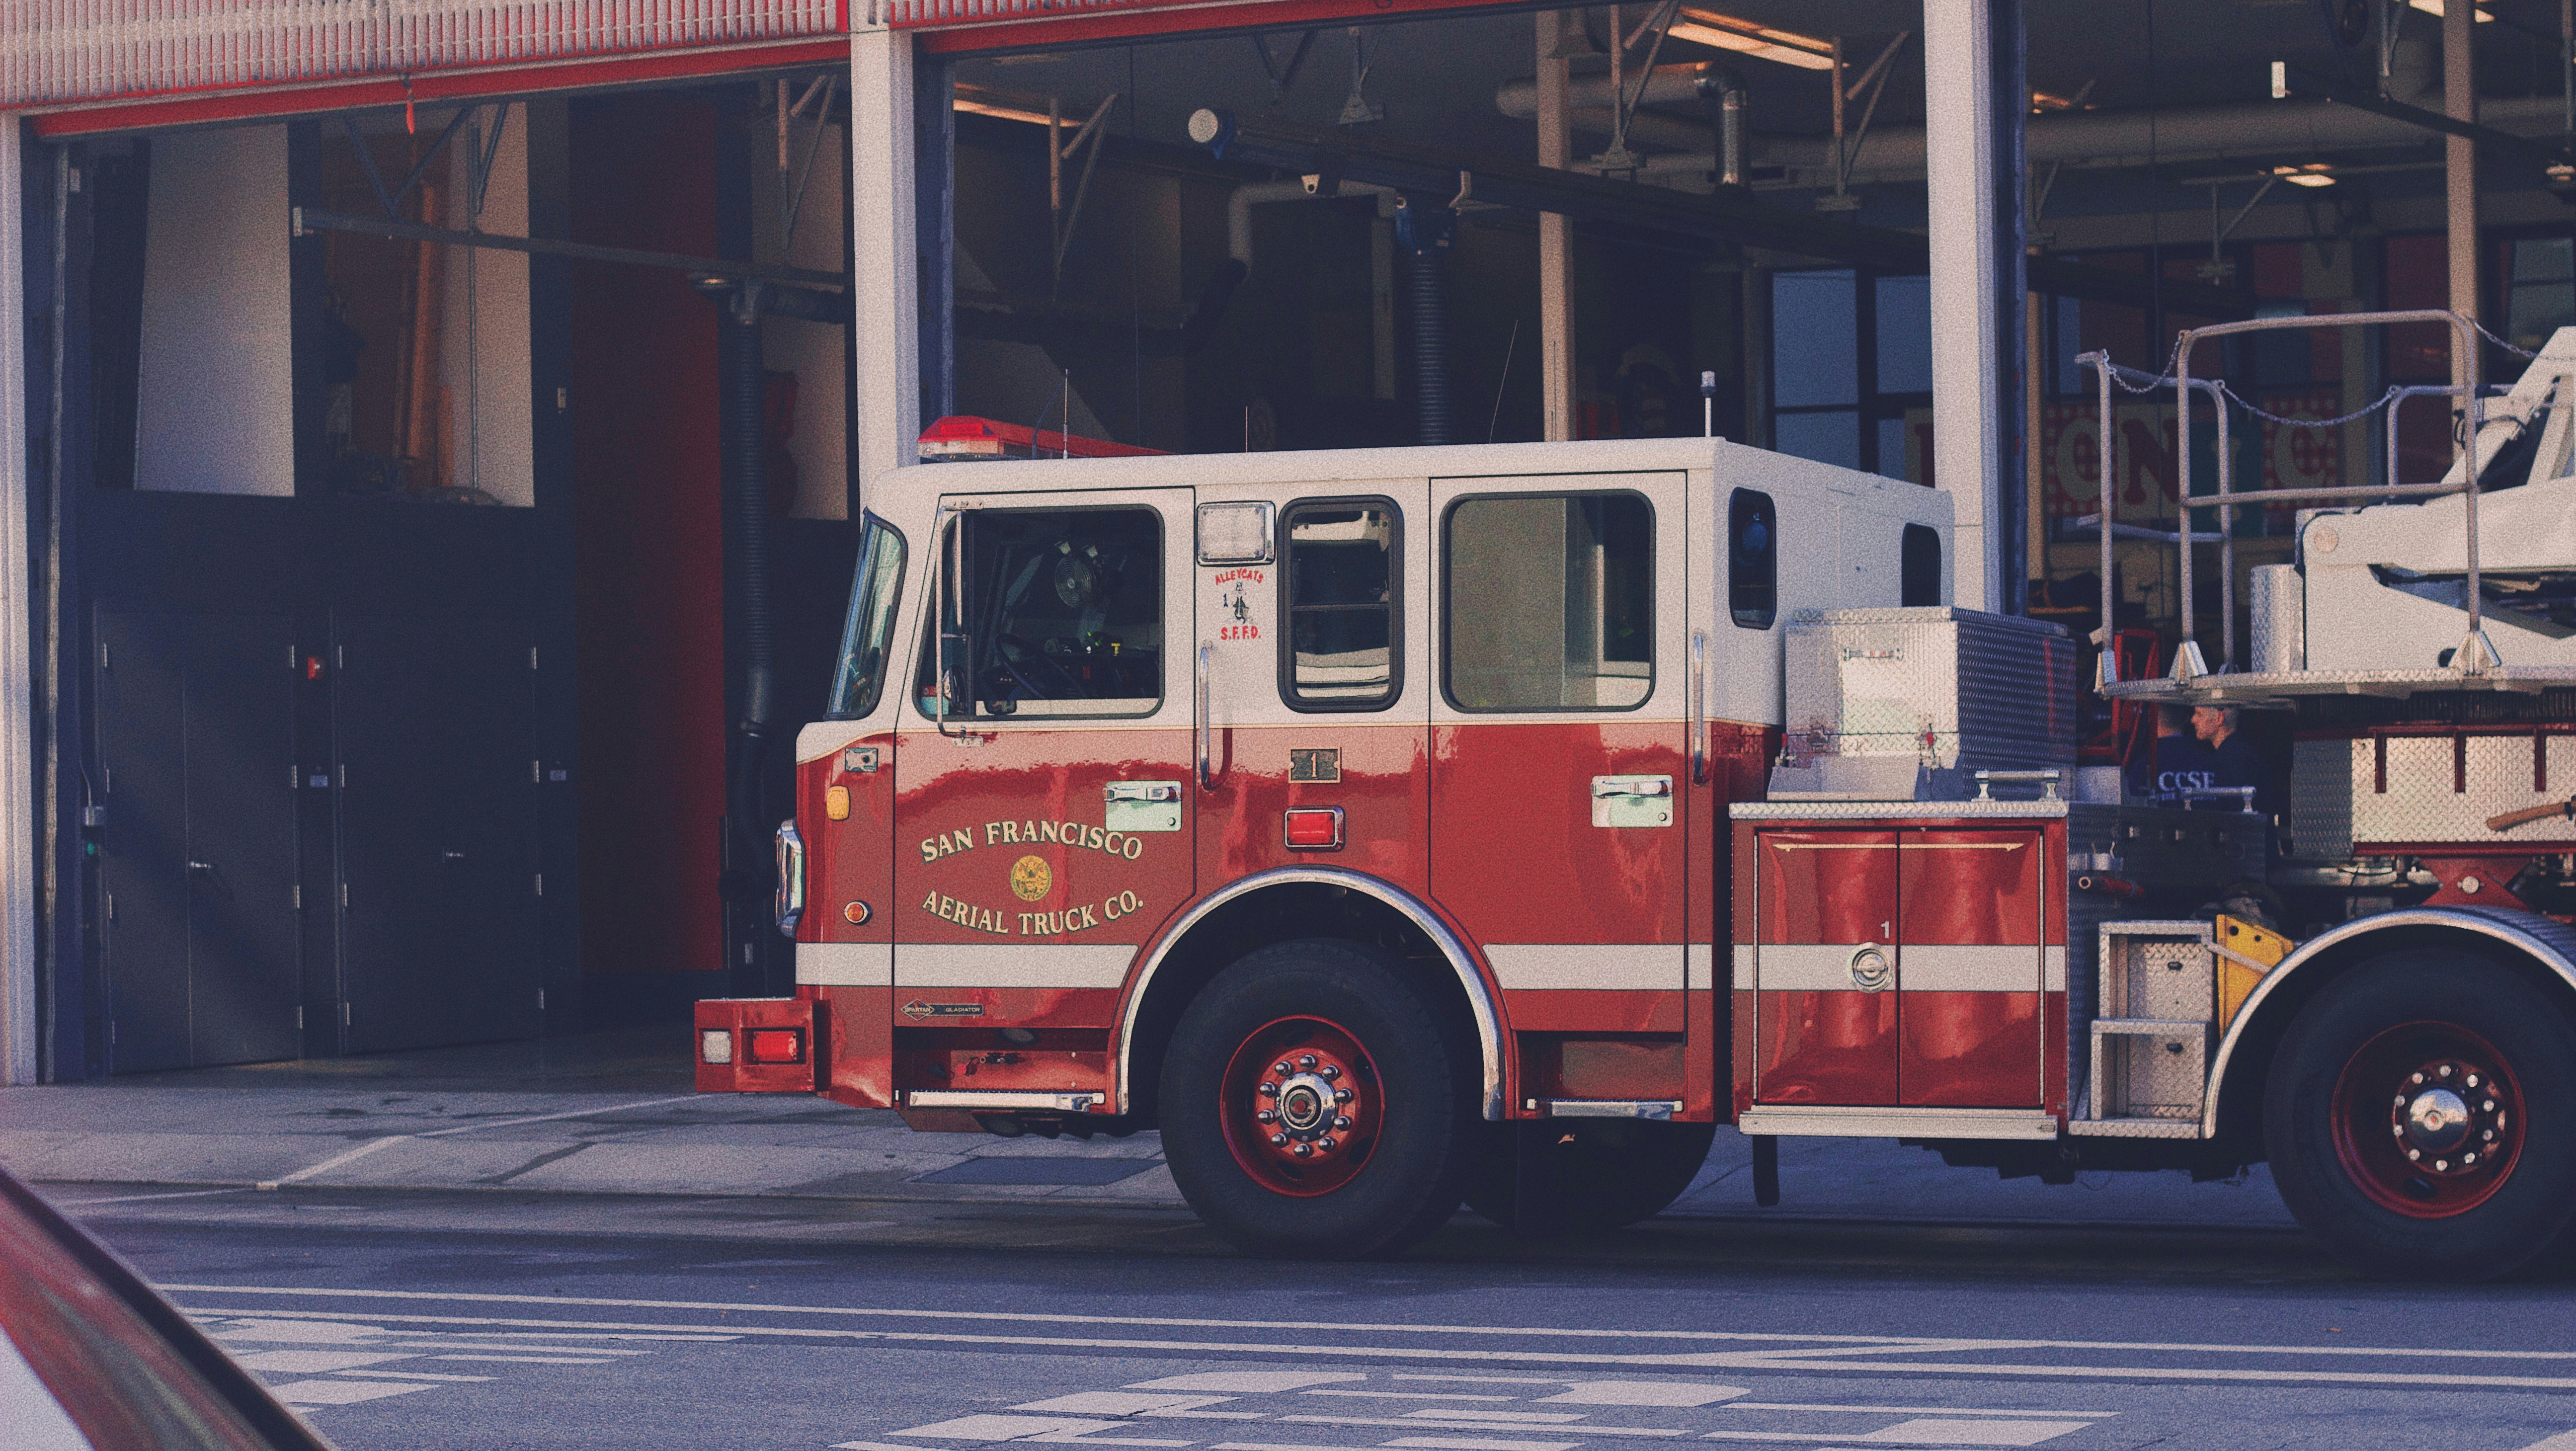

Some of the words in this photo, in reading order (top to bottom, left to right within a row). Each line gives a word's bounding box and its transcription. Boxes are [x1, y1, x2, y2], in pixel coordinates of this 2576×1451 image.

[1215, 568, 1263, 585] ALLEYCATS
[1223, 594, 1228, 607] 1
[1221, 626, 1261, 640] S.F.F.D.
[1311, 752, 1317, 778] 1
[920, 827, 974, 863] SAN
[985, 820, 1143, 860] FRANCISCO
[922, 890, 1009, 934] AERIAL
[1018, 903, 1098, 935] TRUCK
[1104, 889, 1144, 920] CO.
[1881, 921, 1890, 939] 1
